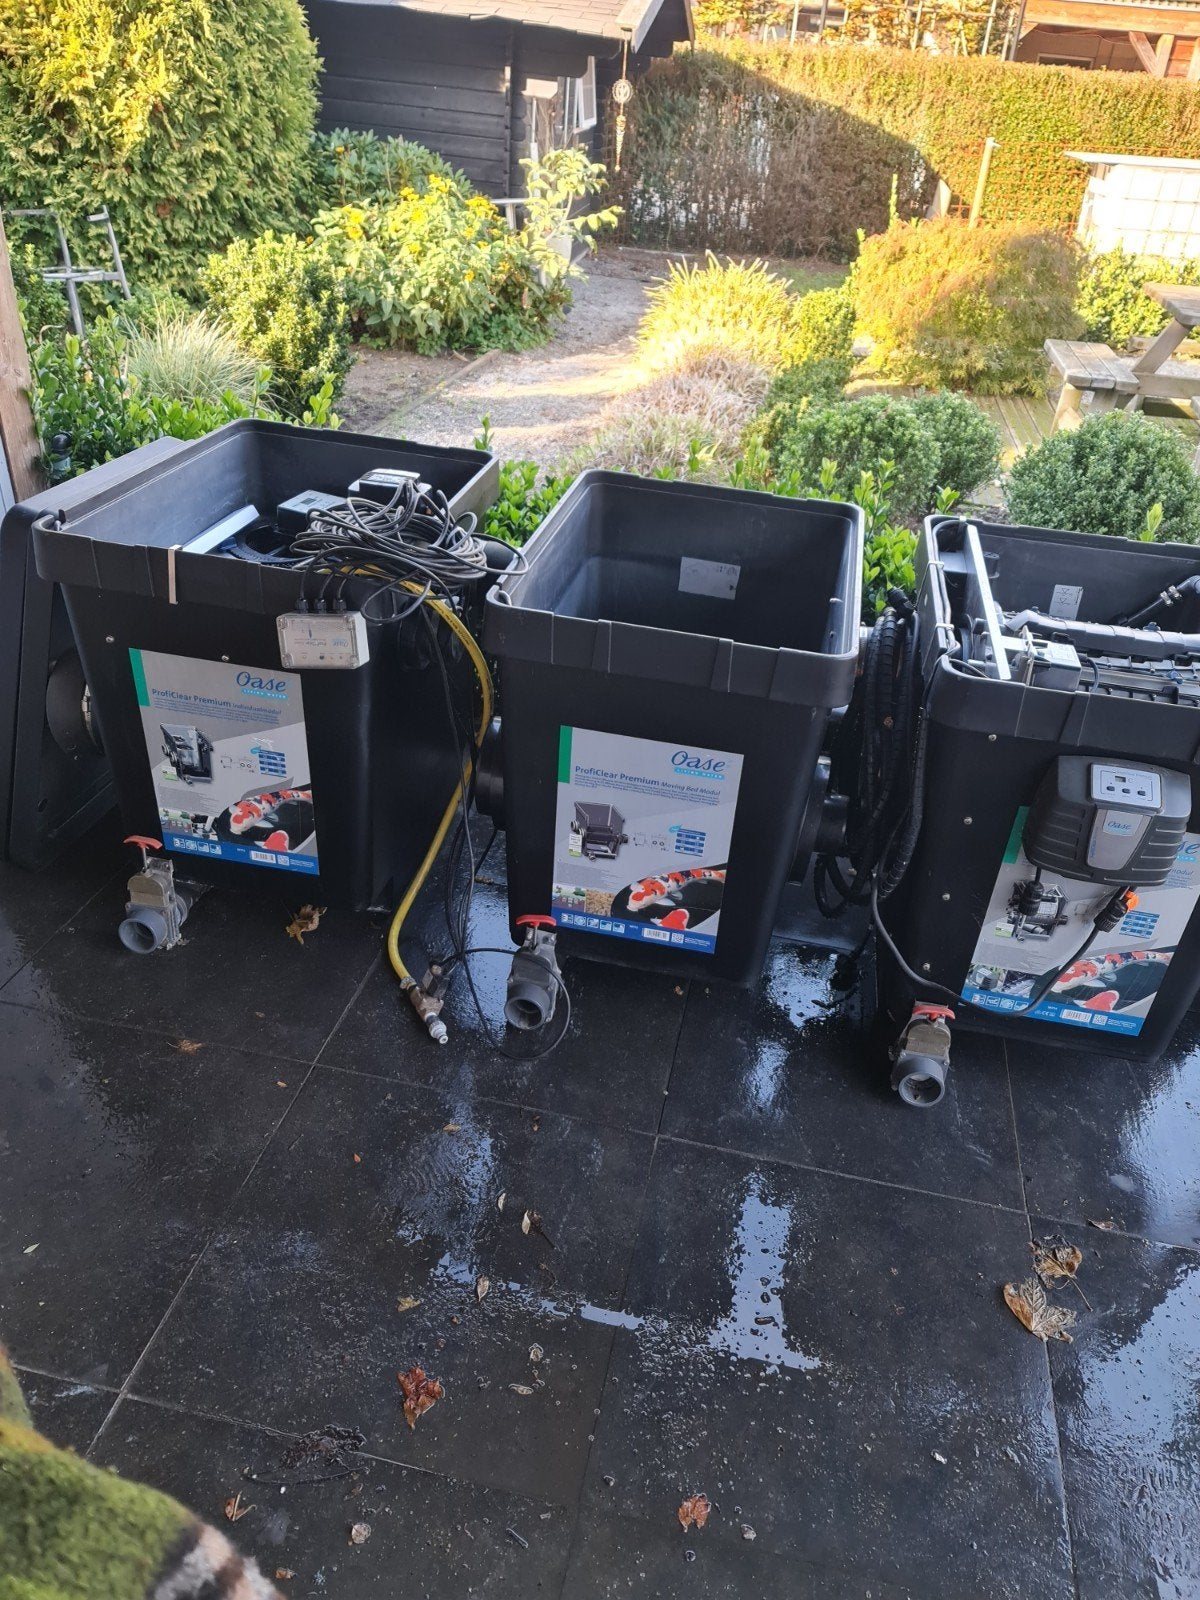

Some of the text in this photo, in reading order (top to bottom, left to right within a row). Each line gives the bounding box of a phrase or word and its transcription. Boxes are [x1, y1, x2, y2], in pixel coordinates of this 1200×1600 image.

[236, 671, 287, 692] Oase
[152, 688, 192, 701] ProfiClear
[193, 694, 231, 707] Premium
[671, 750, 726, 772] Oase
[575, 765, 618, 780] ProfiClear
[619, 772, 660, 786] Premium
[661, 781, 685, 793] Moving
[686, 785, 699, 793] Bed
[700, 787, 721, 797] Modul
